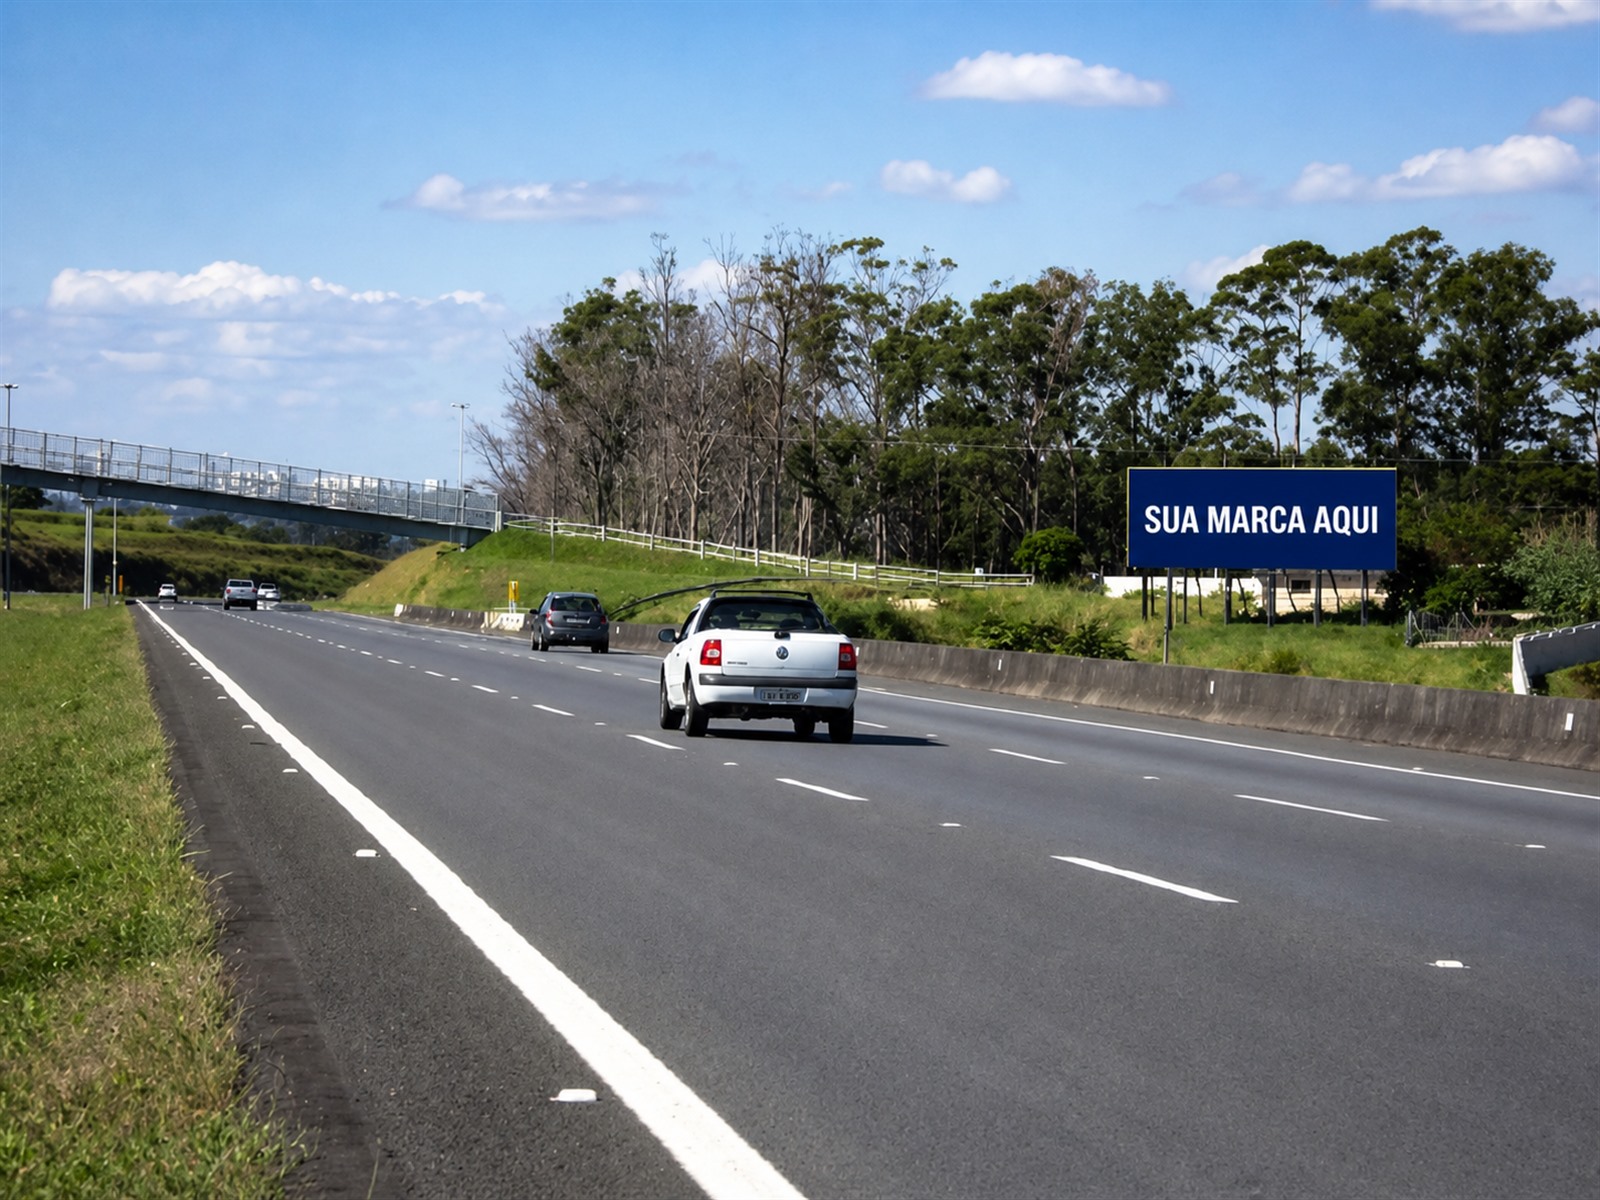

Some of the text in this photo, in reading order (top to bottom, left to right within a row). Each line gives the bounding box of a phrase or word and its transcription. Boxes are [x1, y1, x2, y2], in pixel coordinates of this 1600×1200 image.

[1144, 505, 1378, 536] SUA MARCA AQUI
